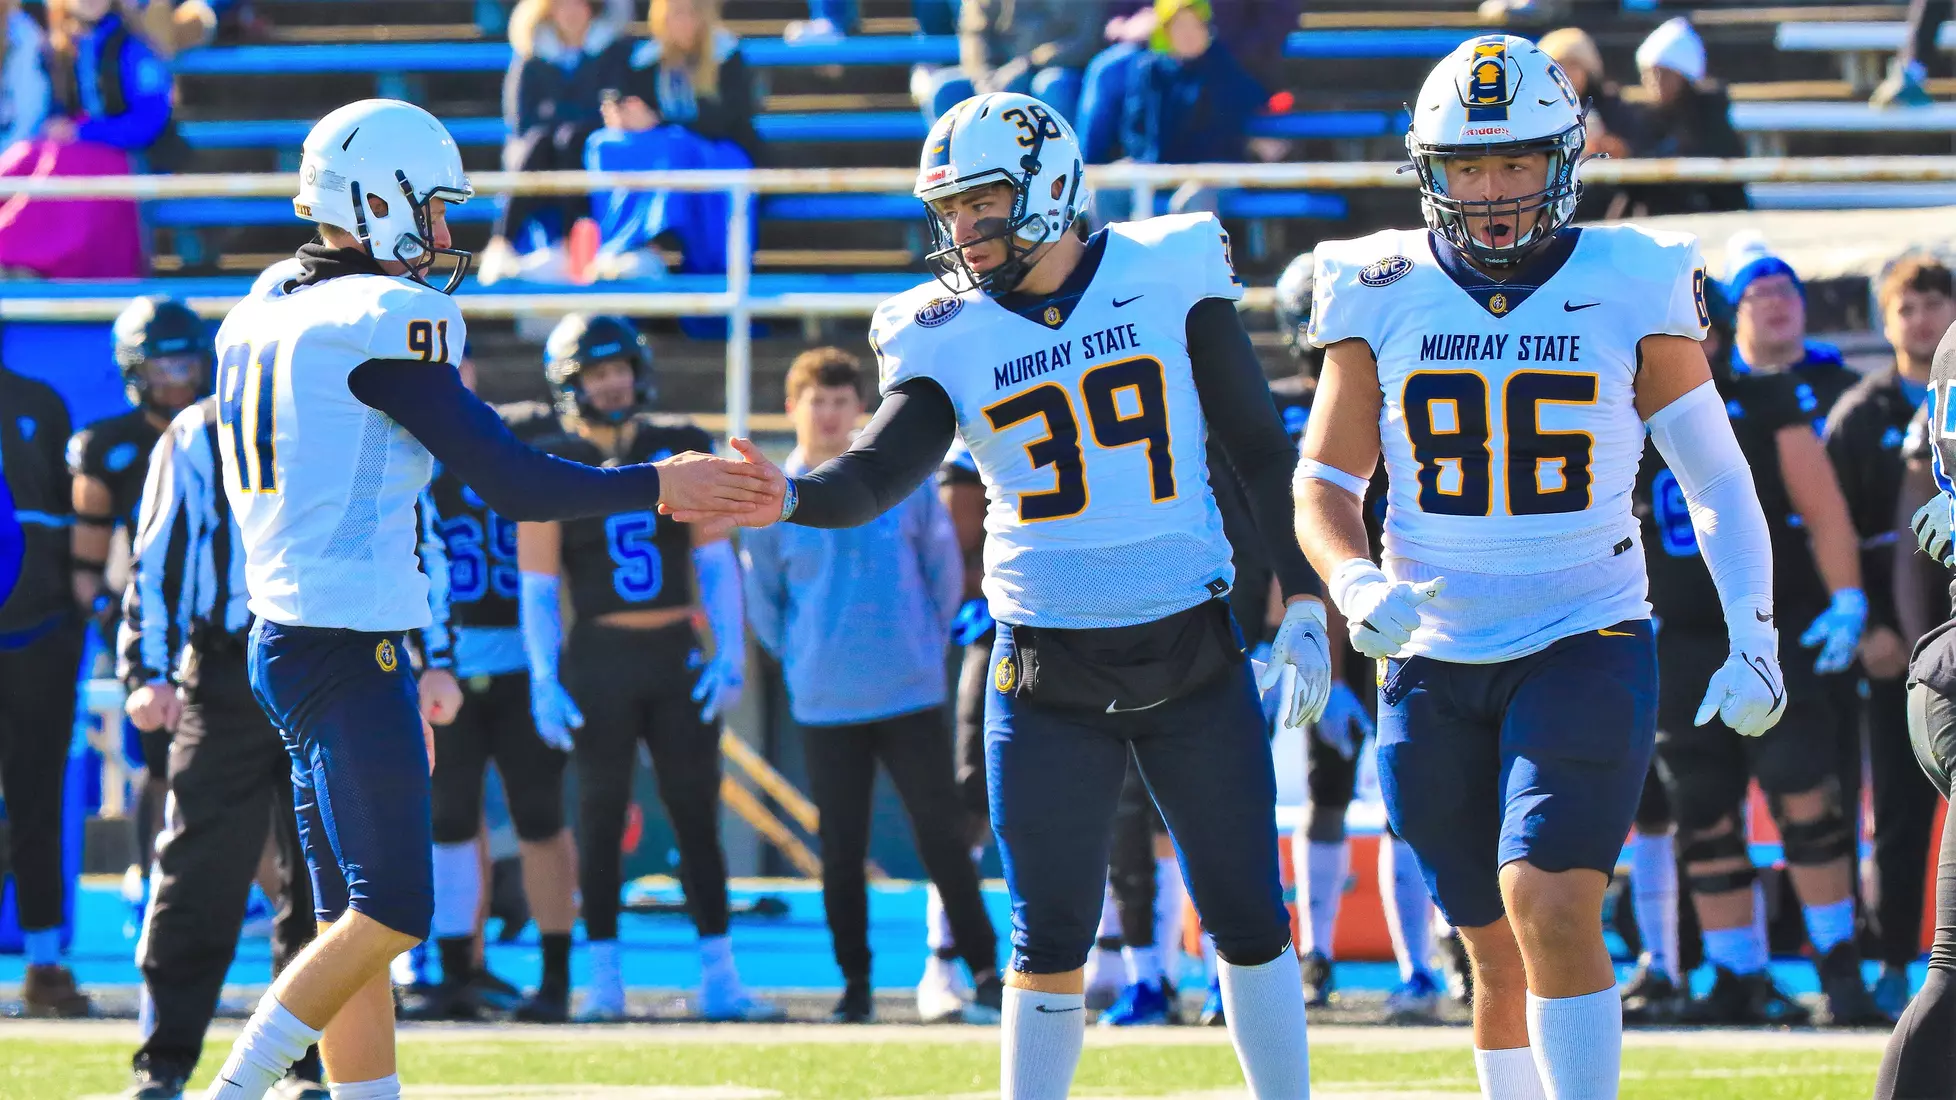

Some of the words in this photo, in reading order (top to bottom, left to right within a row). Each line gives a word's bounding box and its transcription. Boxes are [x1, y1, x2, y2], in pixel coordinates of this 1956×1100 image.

[406, 318, 449, 363] 91
[994, 340, 1072, 390] MURRAY
[1082, 323, 1141, 360] STATE
[1420, 333, 1509, 361] MURRAY
[1517, 335, 1580, 362] STATE
[218, 339, 280, 493] 91
[981, 353, 1179, 524] 39
[1400, 368, 1600, 517] 86
[604, 509, 663, 602] 5
